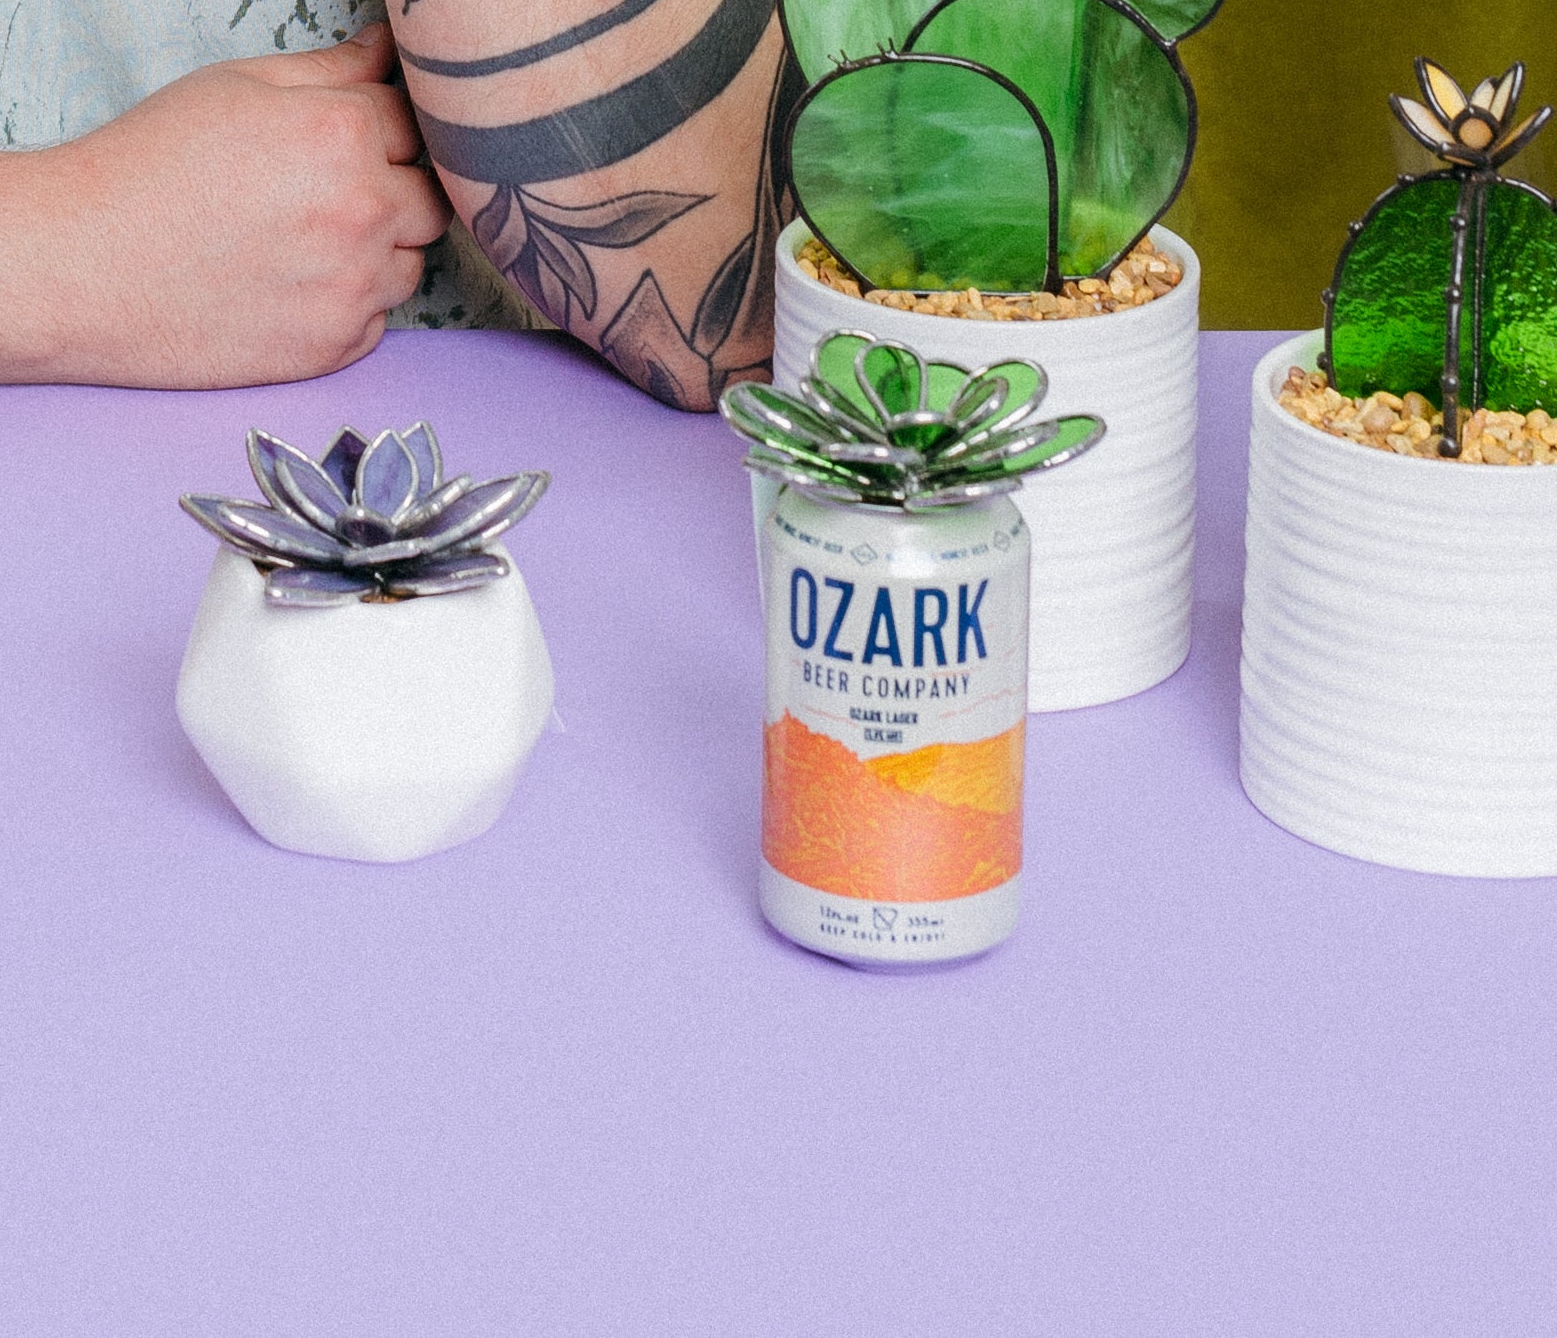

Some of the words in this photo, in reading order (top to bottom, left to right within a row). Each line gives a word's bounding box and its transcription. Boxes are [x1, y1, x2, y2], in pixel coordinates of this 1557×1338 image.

[790, 567, 989, 668] OZARK
[803, 659, 849, 694] BEER
[862, 674, 971, 700] COMPANY
